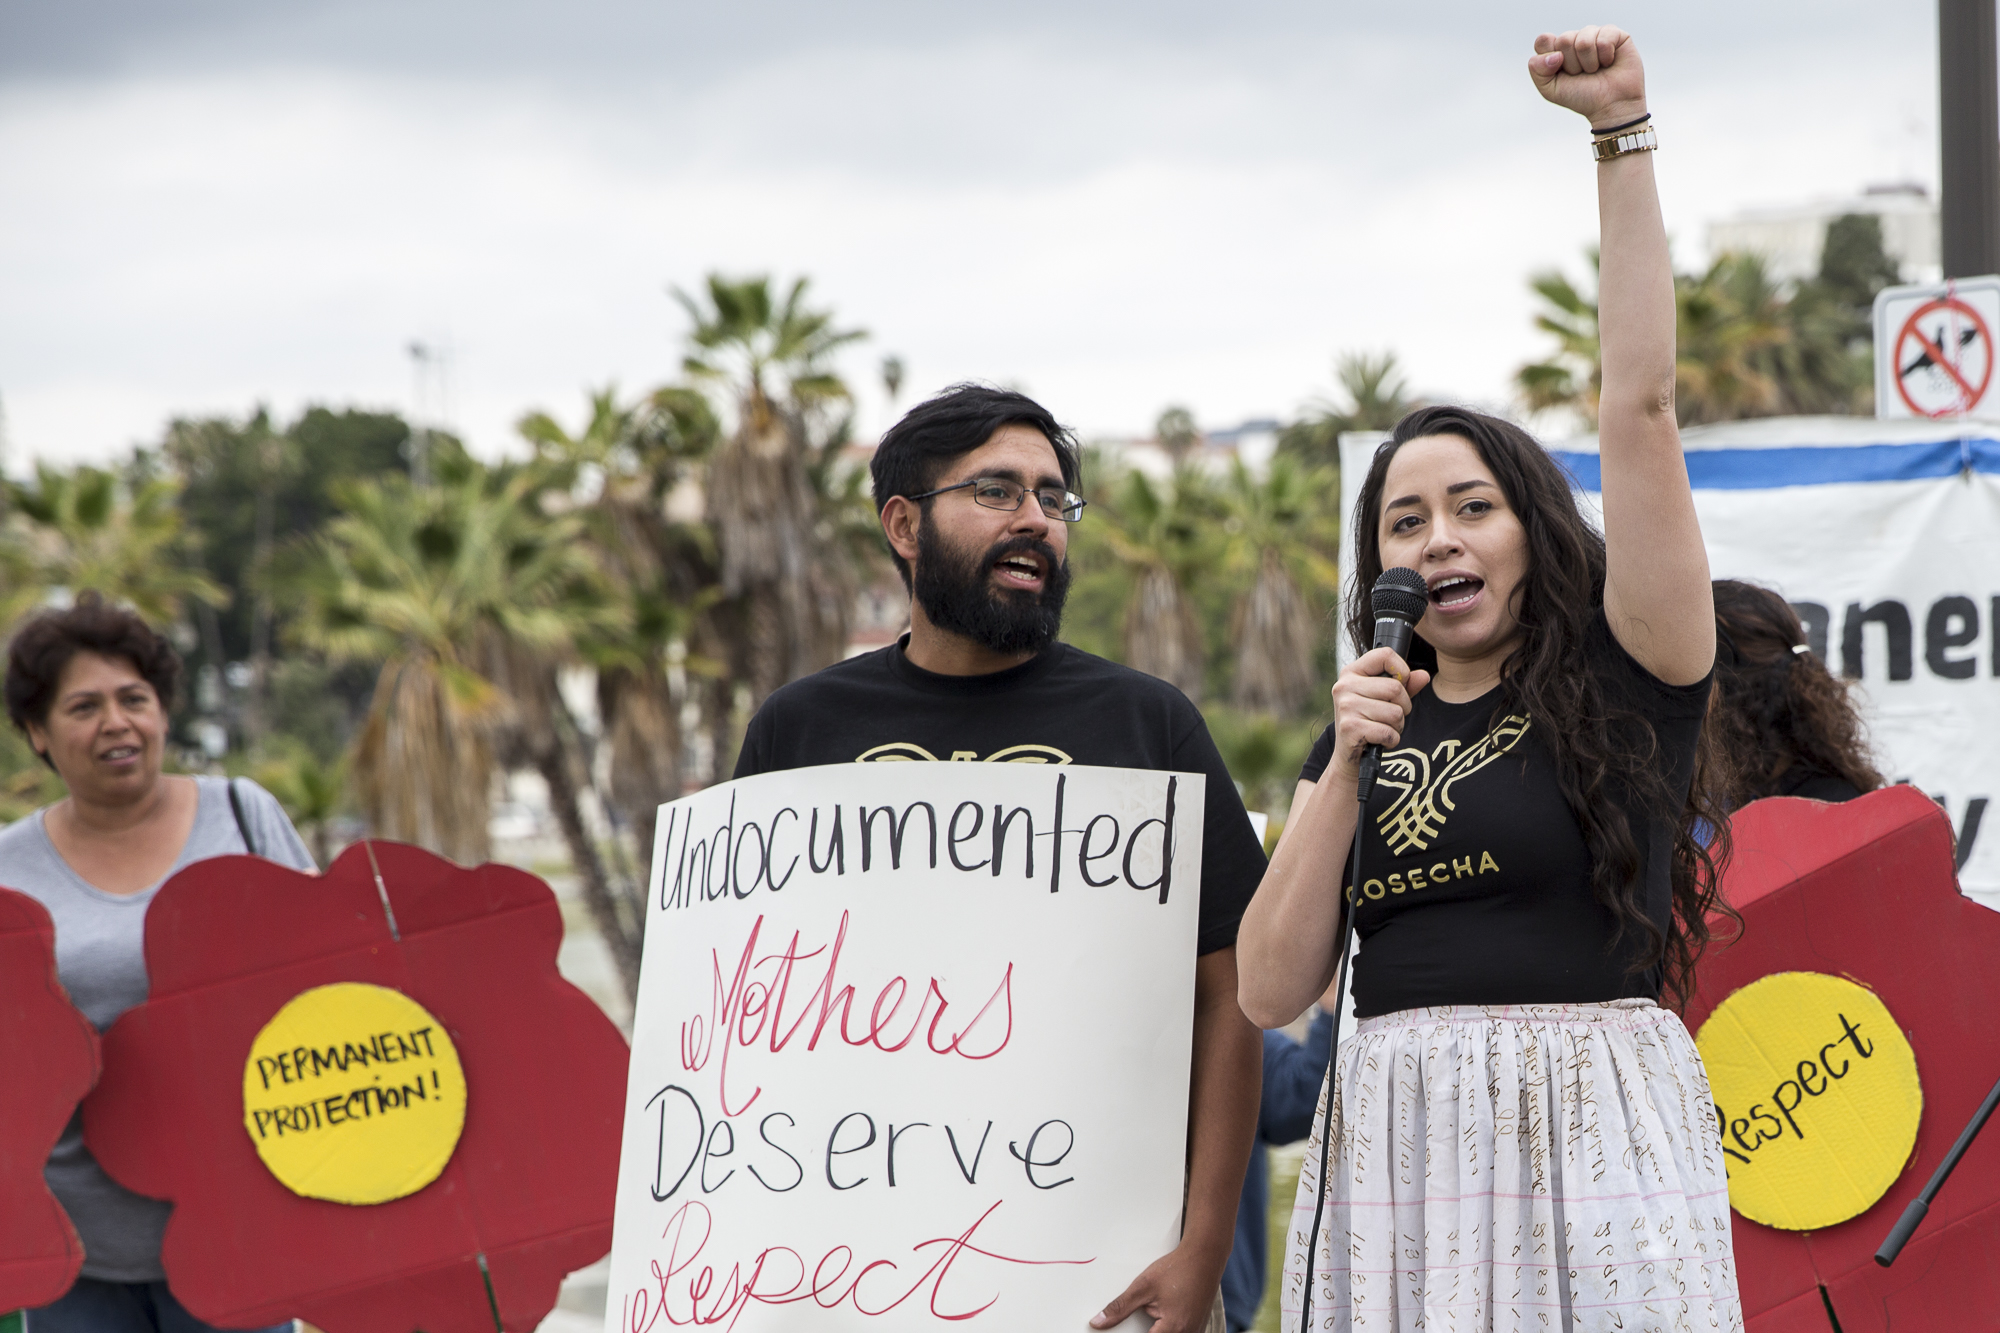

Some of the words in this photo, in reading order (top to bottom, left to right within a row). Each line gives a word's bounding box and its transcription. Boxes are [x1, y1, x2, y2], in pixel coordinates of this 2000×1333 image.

[660, 773, 1178, 911] Undocumented
[257, 1026, 435, 1090] PERMANENT
[680, 908, 1013, 1117] Mothers
[644, 1084, 1075, 1202] Deserve
[622, 1199, 1098, 1333] Respect
